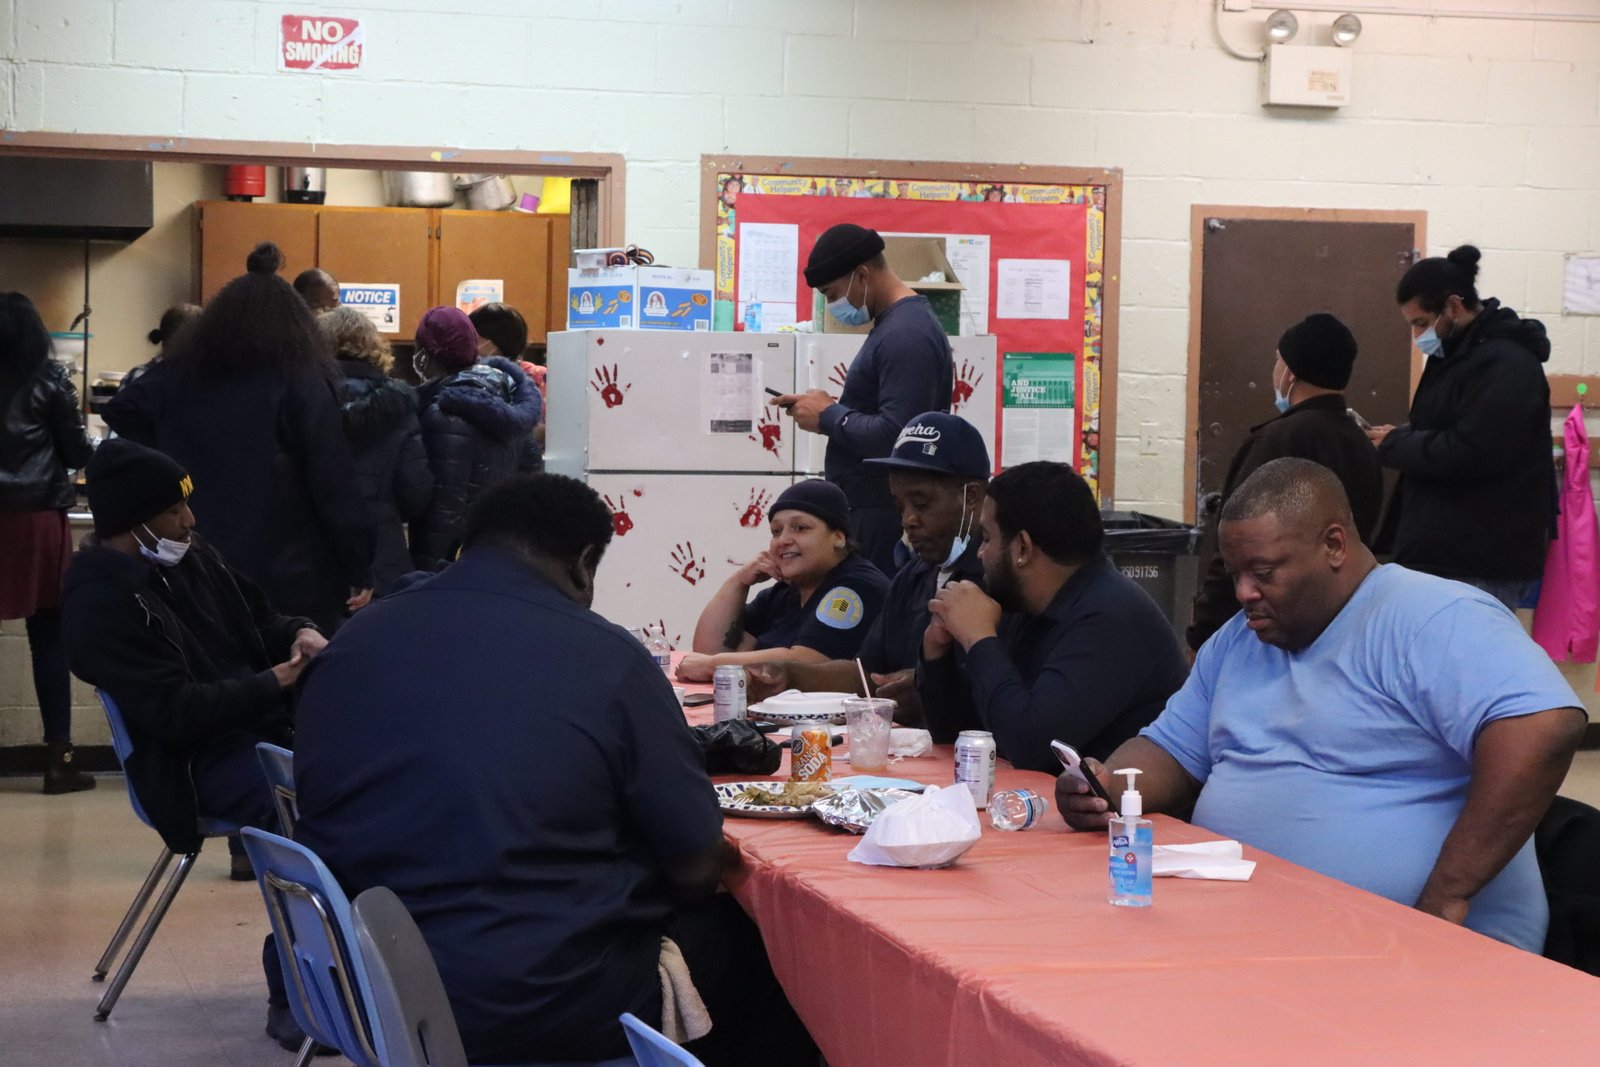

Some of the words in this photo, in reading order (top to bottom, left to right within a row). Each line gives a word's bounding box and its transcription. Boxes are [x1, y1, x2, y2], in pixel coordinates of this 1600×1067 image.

[301, 20, 344, 42] NO
[285, 41, 360, 64] SMOKING
[761, 178, 808, 187] Community
[770, 185, 801, 194] Helpers
[911, 184, 956, 193] Community
[1022, 188, 1065, 196] Community
[919, 191, 950, 200] Helpers
[1029, 194, 1059, 203] Helpers
[719, 240, 727, 288] Community
[344, 290, 392, 303] NOTICE
[1010, 386, 1047, 394] JUSTICE
[793, 744, 821, 772] ORANGE
[797, 752, 827, 781] SODA
